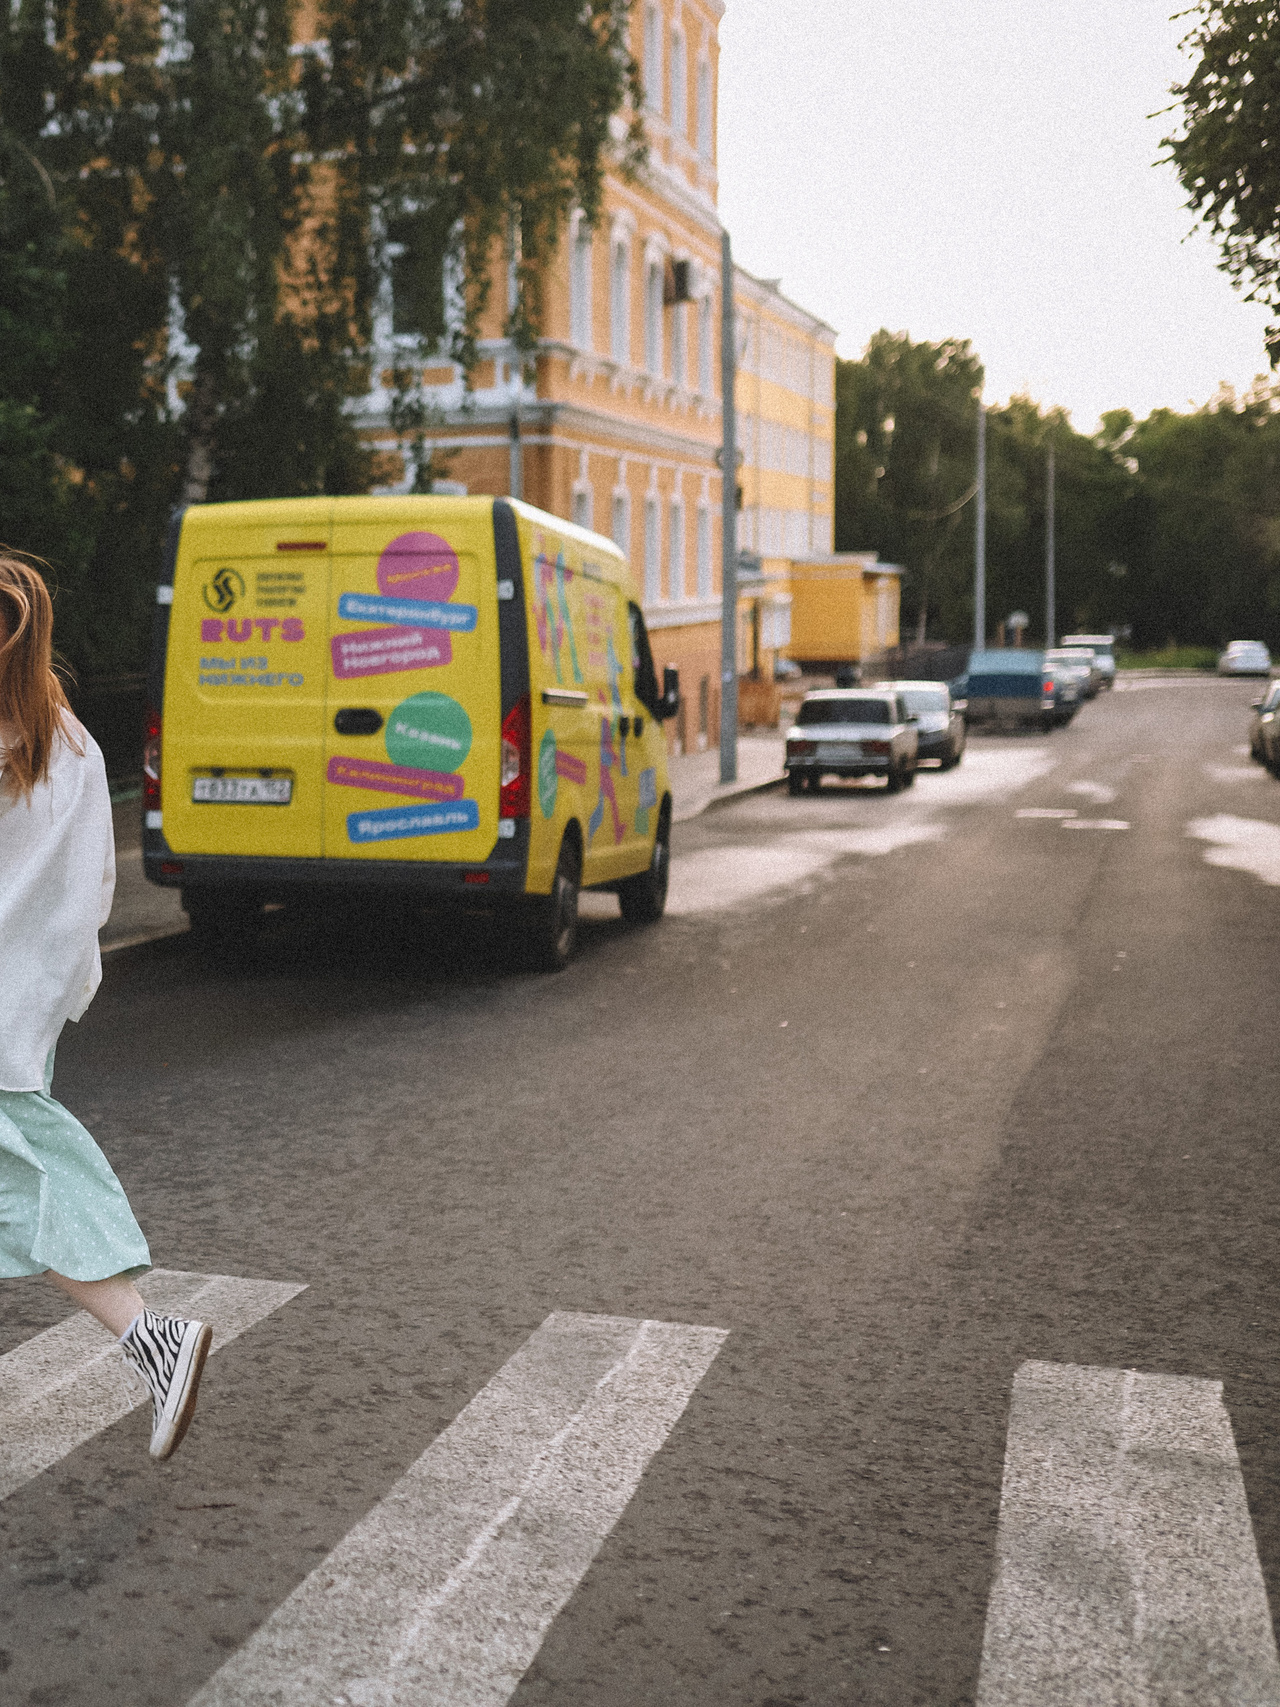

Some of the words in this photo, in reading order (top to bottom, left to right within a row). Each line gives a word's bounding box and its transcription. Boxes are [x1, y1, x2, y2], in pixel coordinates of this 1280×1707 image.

[346, 600, 471, 625] Екатеринбург
[201, 618, 305, 642] RUTS
[341, 633, 423, 654] Нижний
[200, 657, 236, 670] МЫ
[240, 657, 268, 670] ИЗ
[342, 647, 440, 670] Новгород
[199, 673, 305, 687] НИЖНЕГО
[395, 722, 462, 750] Казань
[357, 812, 469, 836] Ярославль
